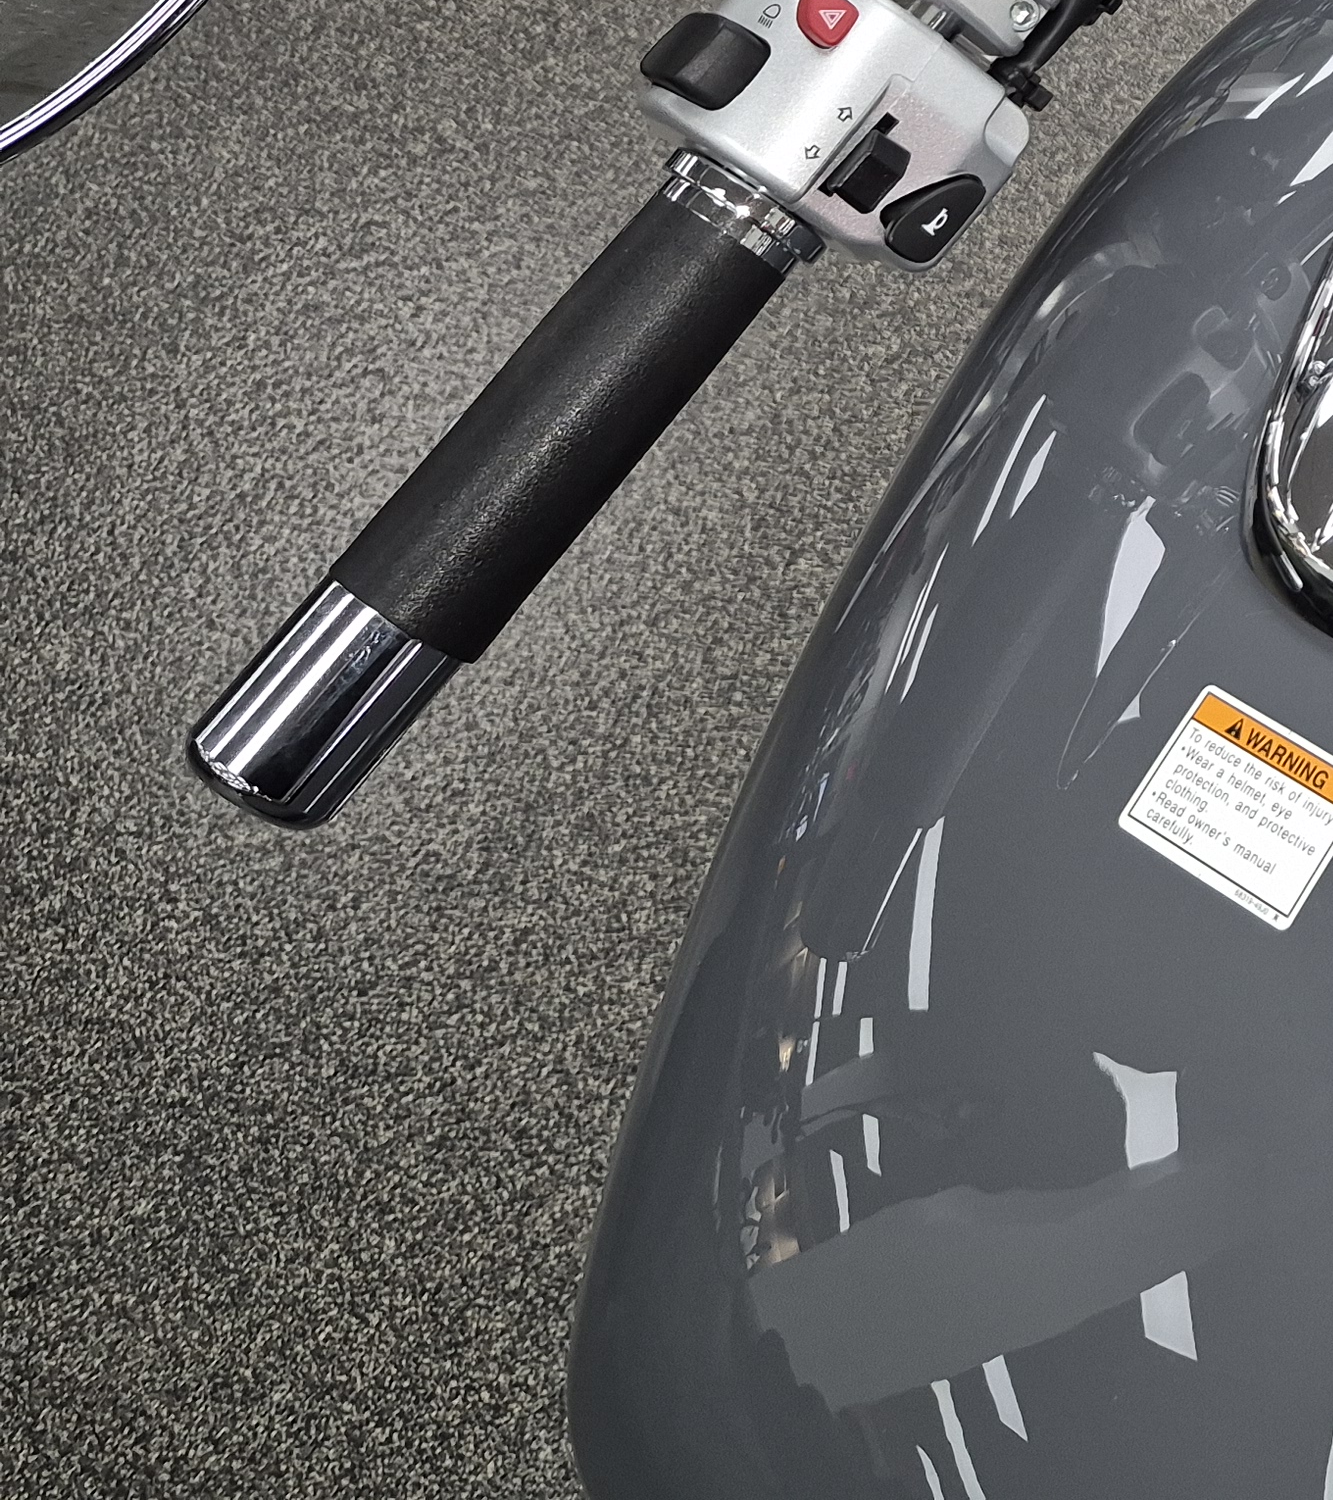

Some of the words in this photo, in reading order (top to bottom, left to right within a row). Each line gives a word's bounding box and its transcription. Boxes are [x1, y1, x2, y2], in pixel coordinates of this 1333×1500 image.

[1189, 727, 1202, 742] To
[1204, 740, 1241, 767] reduce
[1243, 762, 1262, 779] the
[1264, 777, 1284, 794] risk
[1288, 791, 1302, 802] of
[1246, 728, 1328, 789] WARNING
[1161, 779, 1208, 812] clothing.
[1172, 764, 1229, 805] protection,
[1234, 801, 1258, 819] and
[1257, 816, 1315, 855] protective
[1215, 768, 1224, 778] a
[1227, 773, 1265, 806] helmet,
[1271, 802, 1292, 819] eye
[1146, 808, 1194, 844] carefully.
[1187, 814, 1230, 846] owner's
[1233, 843, 1276, 874] manual
